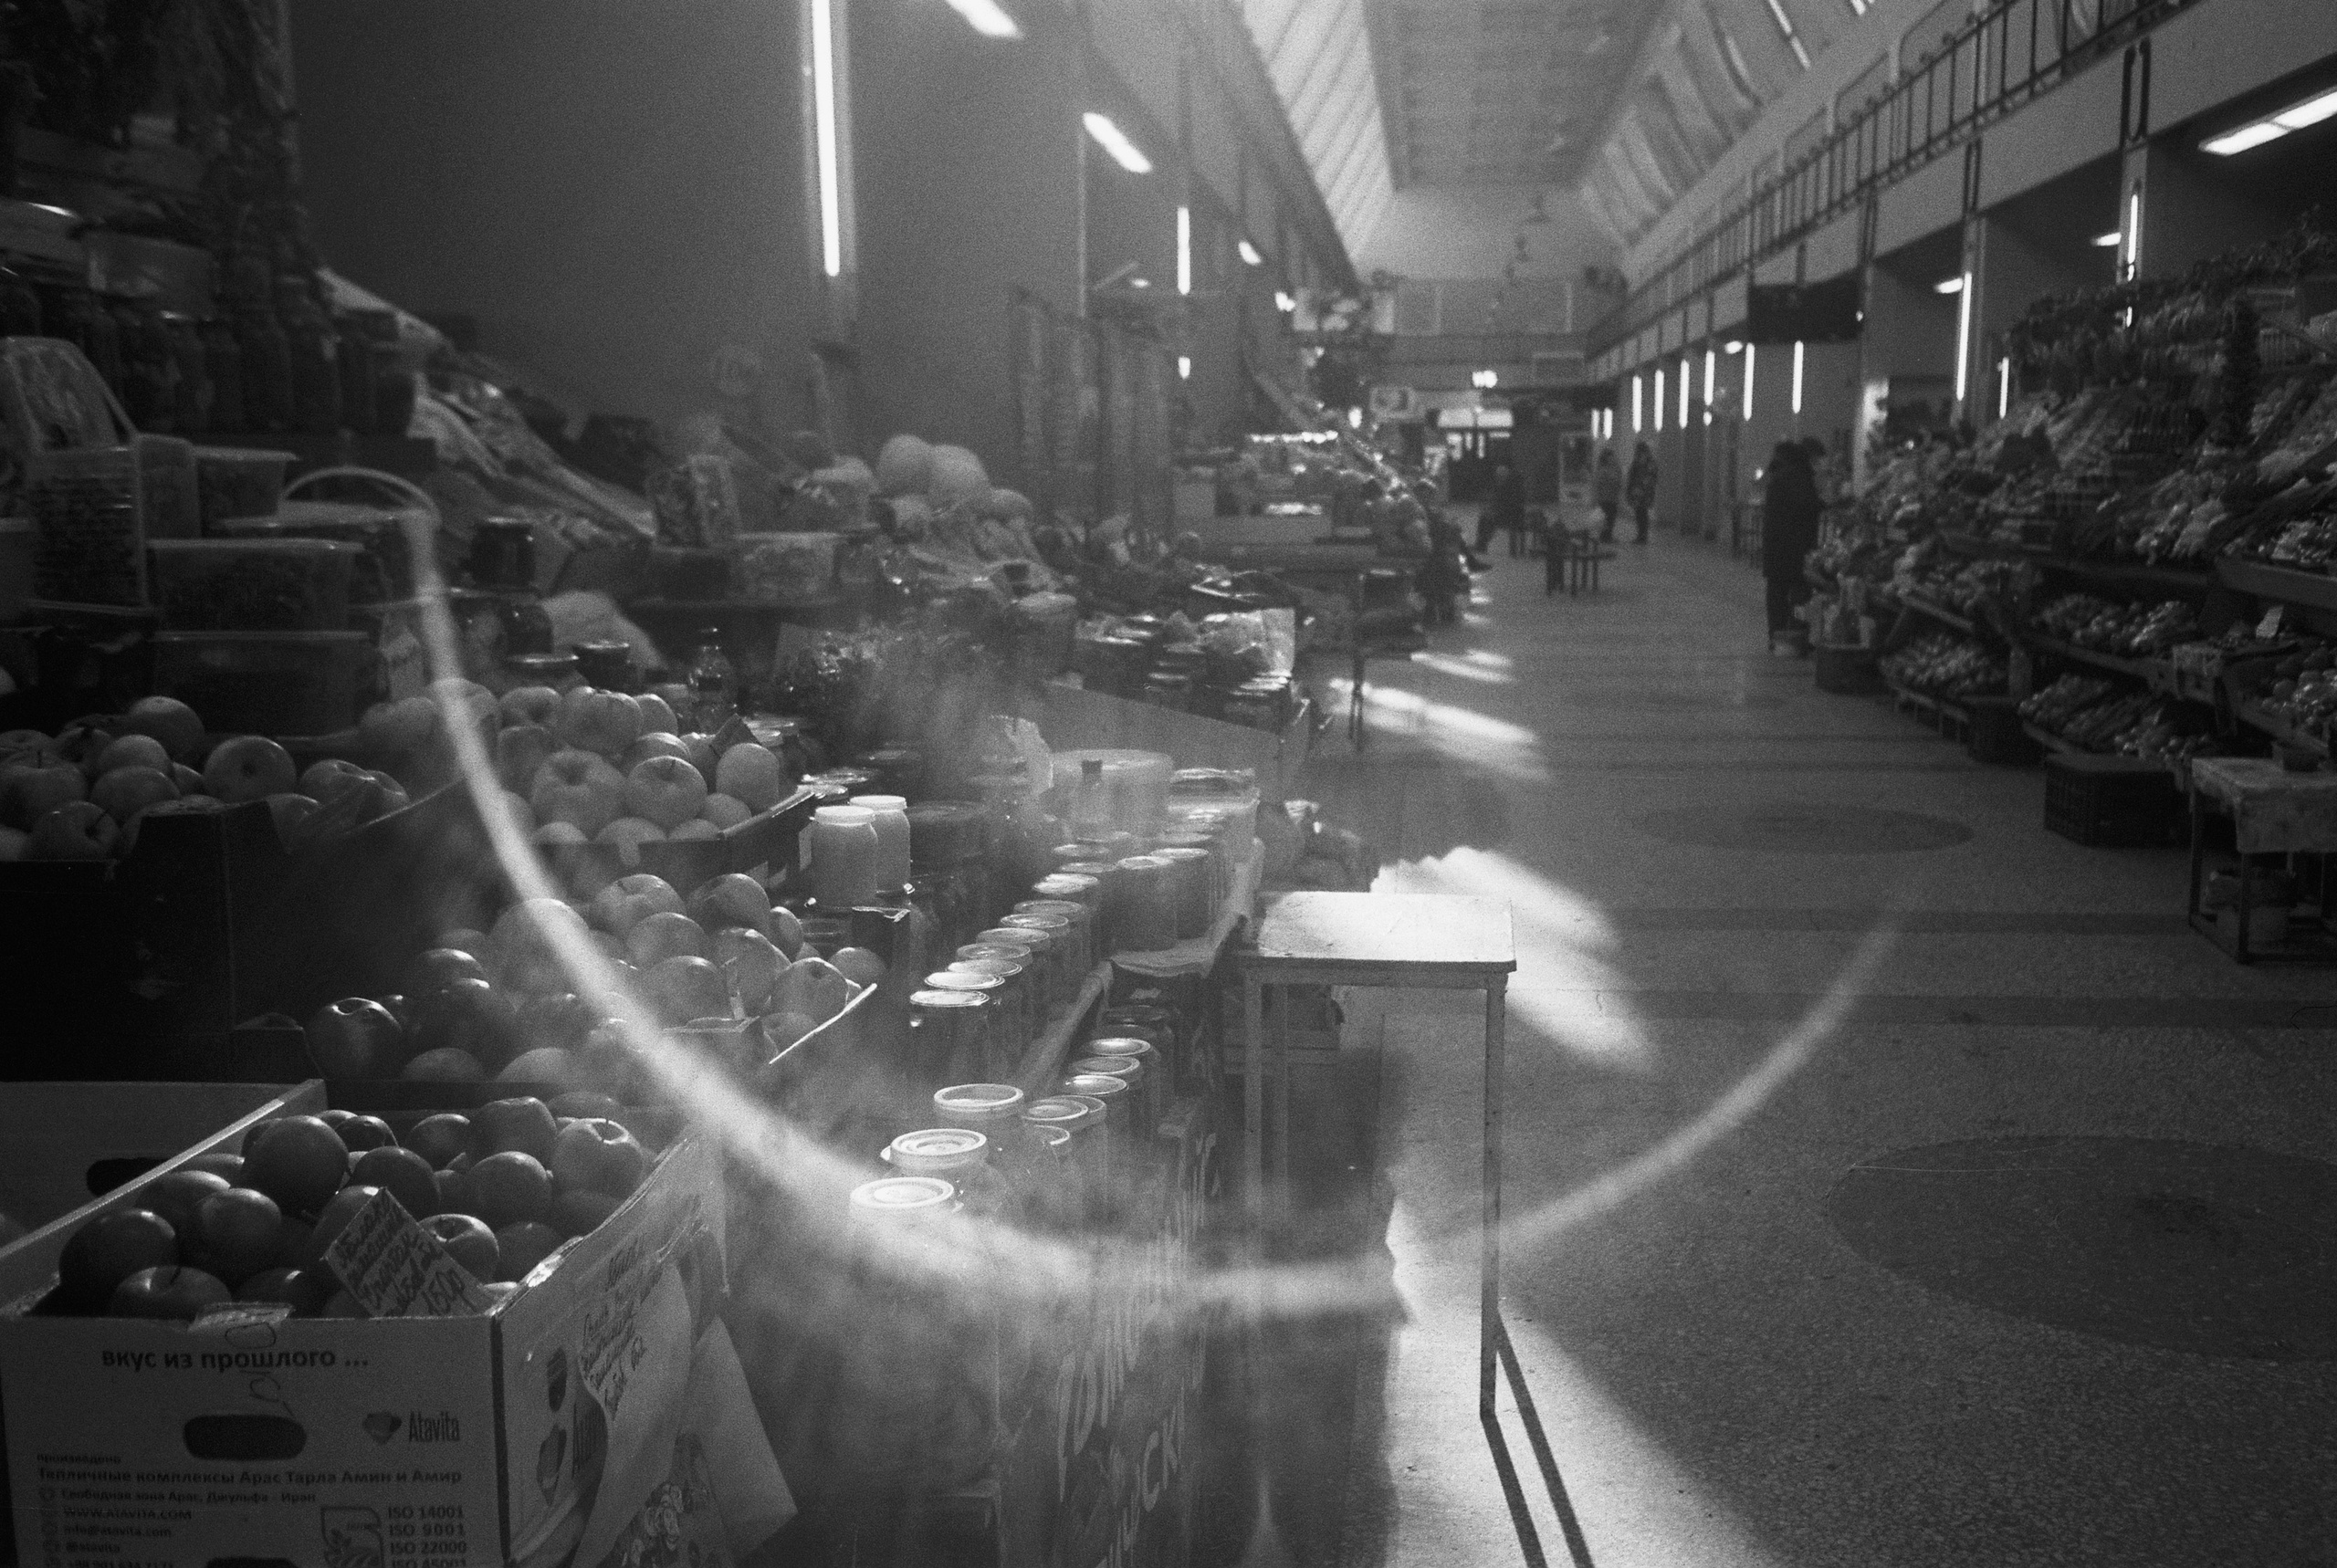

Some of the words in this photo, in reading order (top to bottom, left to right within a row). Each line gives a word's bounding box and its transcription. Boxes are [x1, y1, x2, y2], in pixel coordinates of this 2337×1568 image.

[101, 1349, 157, 1372] вкус
[164, 1349, 193, 1368] из
[201, 1348, 337, 1373] прошлого
[408, 1410, 461, 1444] Atavita
[38, 1467, 131, 1481] Тепличные
[136, 1472, 235, 1484] комплексы
[239, 1471, 281, 1485] Арас
[286, 1471, 336, 1485] Тарла
[341, 1470, 391, 1483] Амин
[396, 1472, 407, 1483] и
[413, 1470, 462, 1484] Амир
[281, 1492, 317, 1505] Иран
[387, 1505, 414, 1520] ISO
[419, 1505, 464, 1520] 14001
[389, 1522, 415, 1537] ISO
[422, 1522, 466, 1537] 9001
[390, 1541, 416, 1555] ISO
[421, 1540, 467, 1555] 22000
